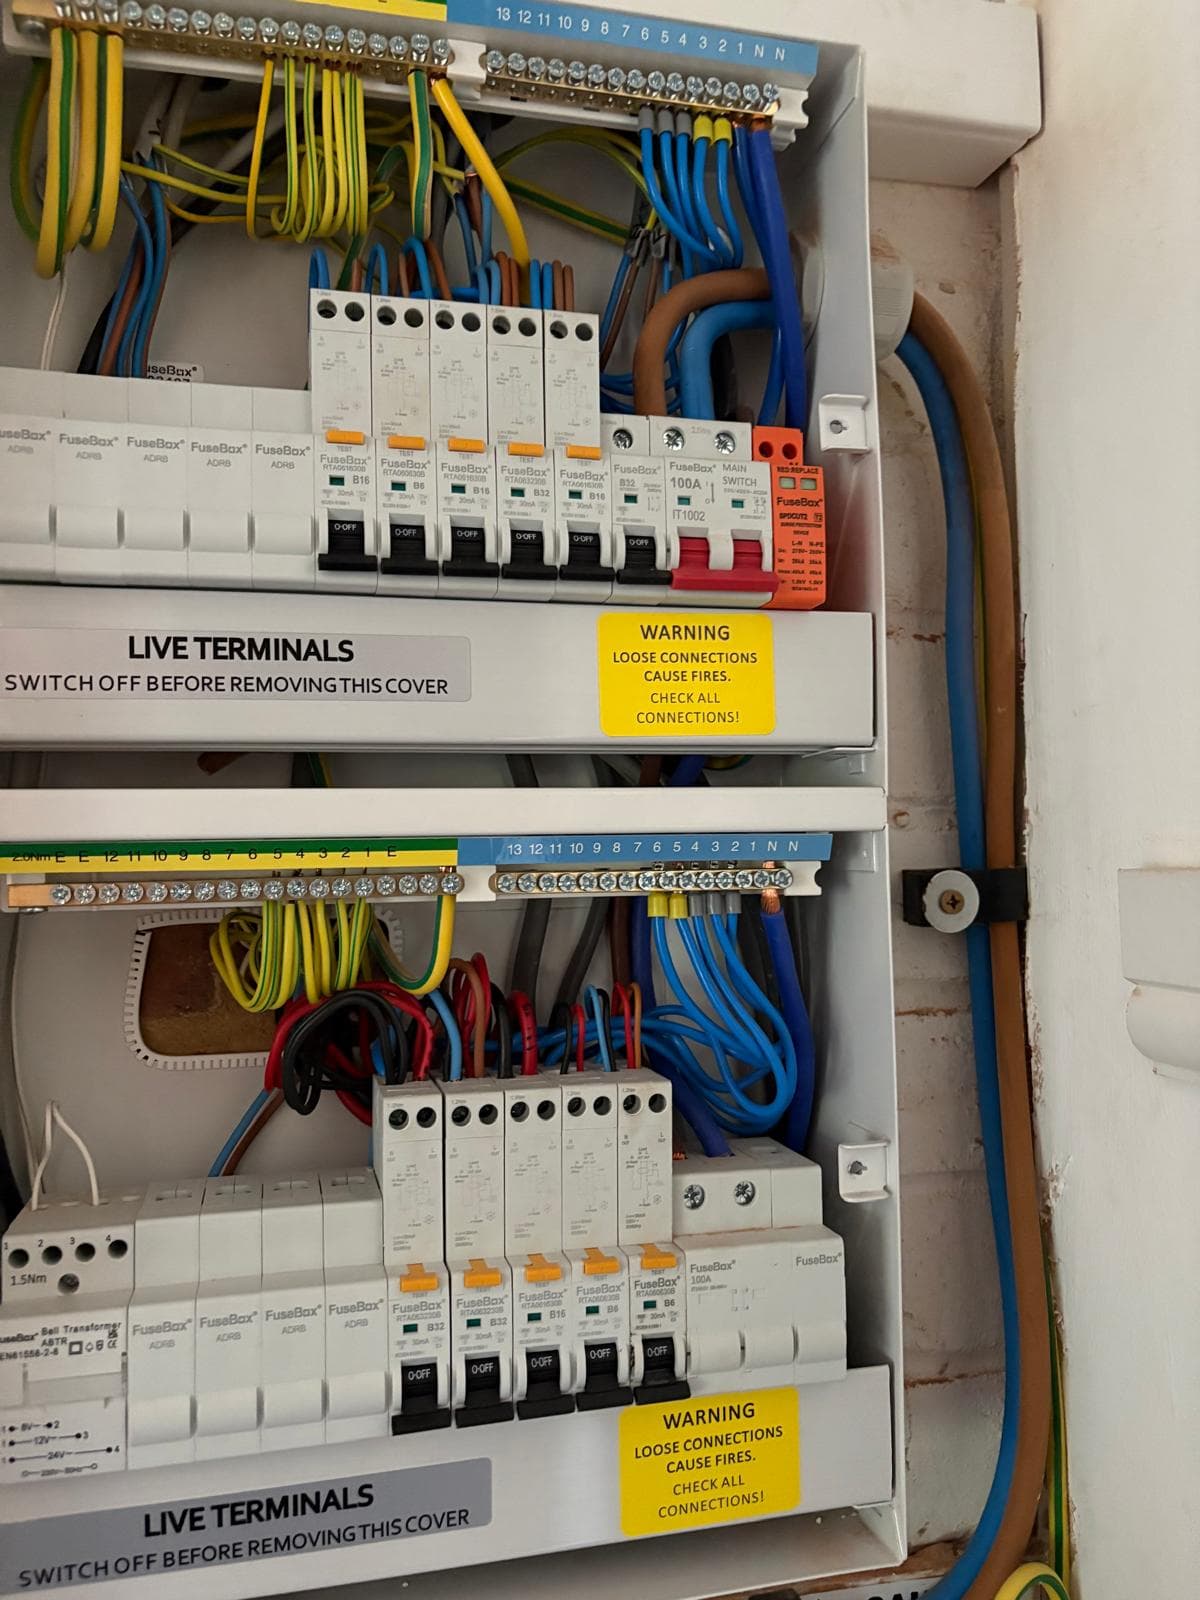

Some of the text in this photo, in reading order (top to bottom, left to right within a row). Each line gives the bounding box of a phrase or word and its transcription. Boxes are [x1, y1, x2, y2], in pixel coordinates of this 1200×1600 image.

[496, 7, 784, 61] 13 12 11 10 9 8 7 6 5 4 3 2 1 N N
[147, 365, 192, 377] seBox
[0, 429, 46, 441] useBox
[722, 463, 747, 473] MAIN
[670, 477, 702, 490] 100A
[722, 475, 757, 488] SWITCH
[672, 509, 706, 521] IT1002
[640, 624, 730, 641] WARNING
[128, 635, 355, 663] LIVE TERMINALS
[613, 652, 758, 664] LOOSE CONNECTIONS
[5, 674, 449, 695] SWITCH OFF BEFORE REMOVING THIS COVER
[644, 671, 732, 682] CAUSE FIRES.
[650, 692, 721, 704] CHECK ALL
[636, 711, 740, 724] CONNECTIONS!
[55, 852, 66, 863] E
[79, 851, 90, 863] E
[104, 851, 119, 862] 12
[129, 851, 141, 862] 11
[152, 850, 168, 862] 10
[179, 849, 188, 861] 9
[202, 849, 212, 861] 8
[225, 849, 233, 860] 7
[248, 848, 258, 861] 6
[273, 848, 283, 860] 5
[295, 847, 305, 859] 4
[319, 847, 328, 859] 3
[341, 846, 351, 858] 2
[387, 845, 398, 857] E
[507, 840, 798, 856] 13 12 11 10 9 8 7 6 5 4 3 2 1 N N
[0, 1333, 35, 1343] useBox
[663, 1403, 755, 1430] WARNING
[635, 1426, 783, 1459] LOOSE CONNECTIONS
[666, 1450, 756, 1473] CAUSE FIRES.
[673, 1475, 745, 1496] CHECK ALL
[144, 1483, 374, 1537] LIVE TERMINALS
[658, 1491, 764, 1518] CONNECTIONS!
[19, 1509, 469, 1587] SWITCH OFF BEFORE REMOVING THIS COVER
